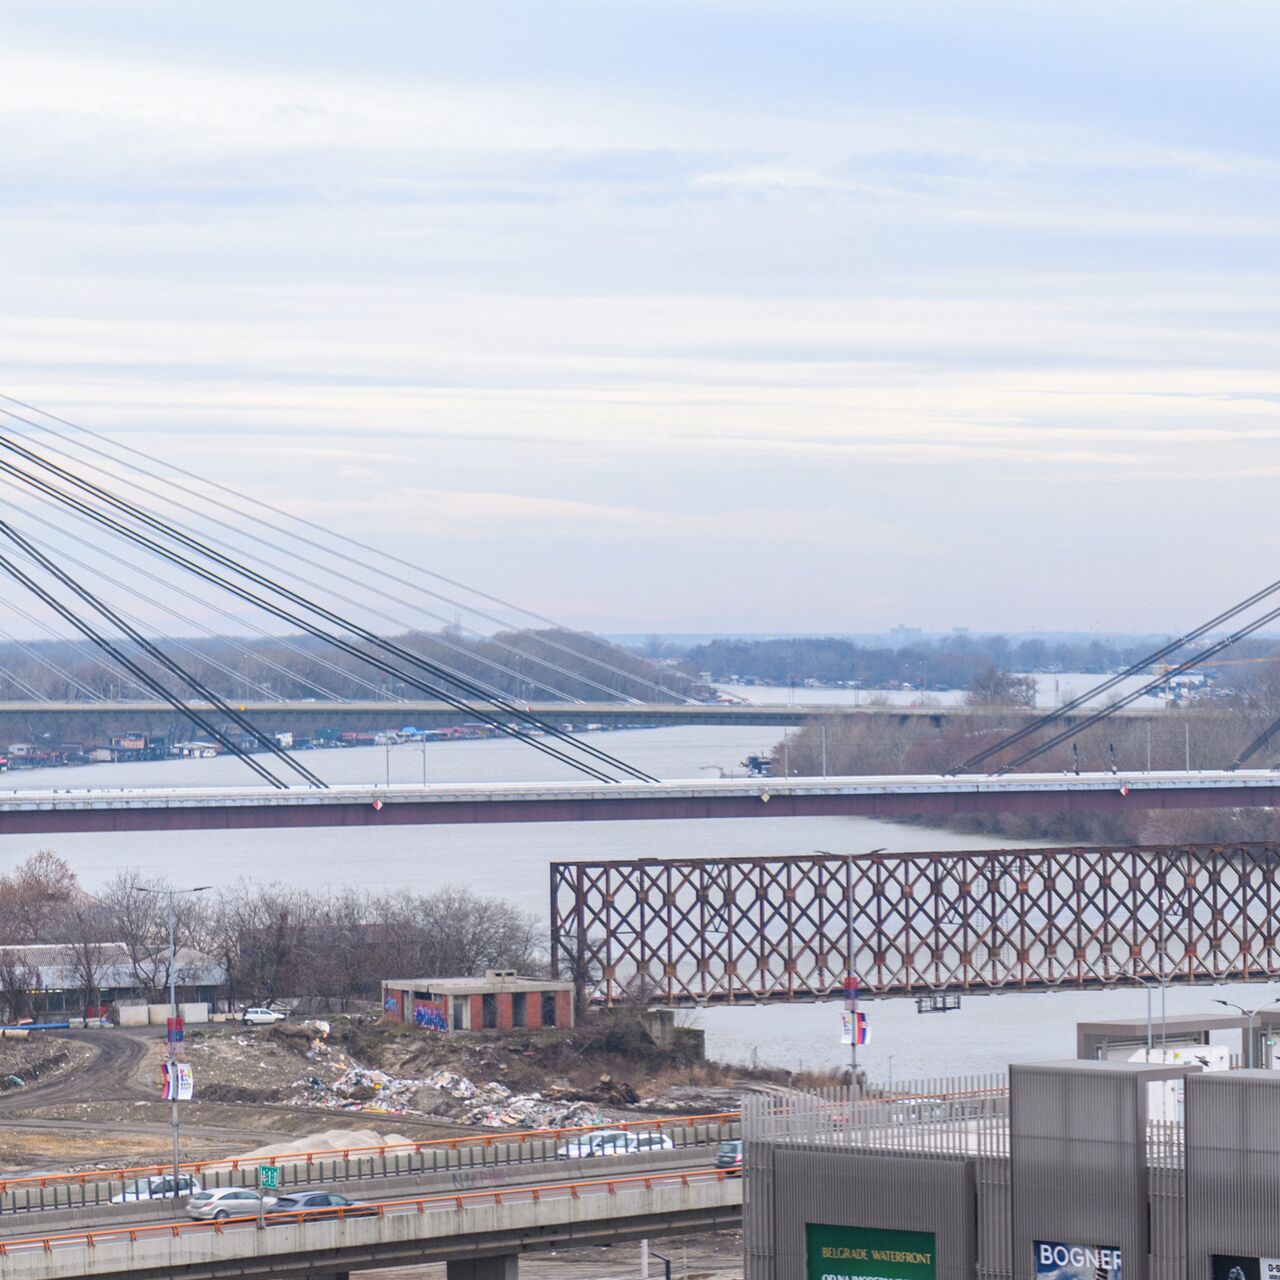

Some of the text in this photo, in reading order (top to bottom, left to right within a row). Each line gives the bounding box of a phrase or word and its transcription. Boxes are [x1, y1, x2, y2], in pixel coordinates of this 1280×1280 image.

[822, 1247, 931, 1265] BELGRADE WATERFRONT
[1040, 1244, 1122, 1270] BOGNER
